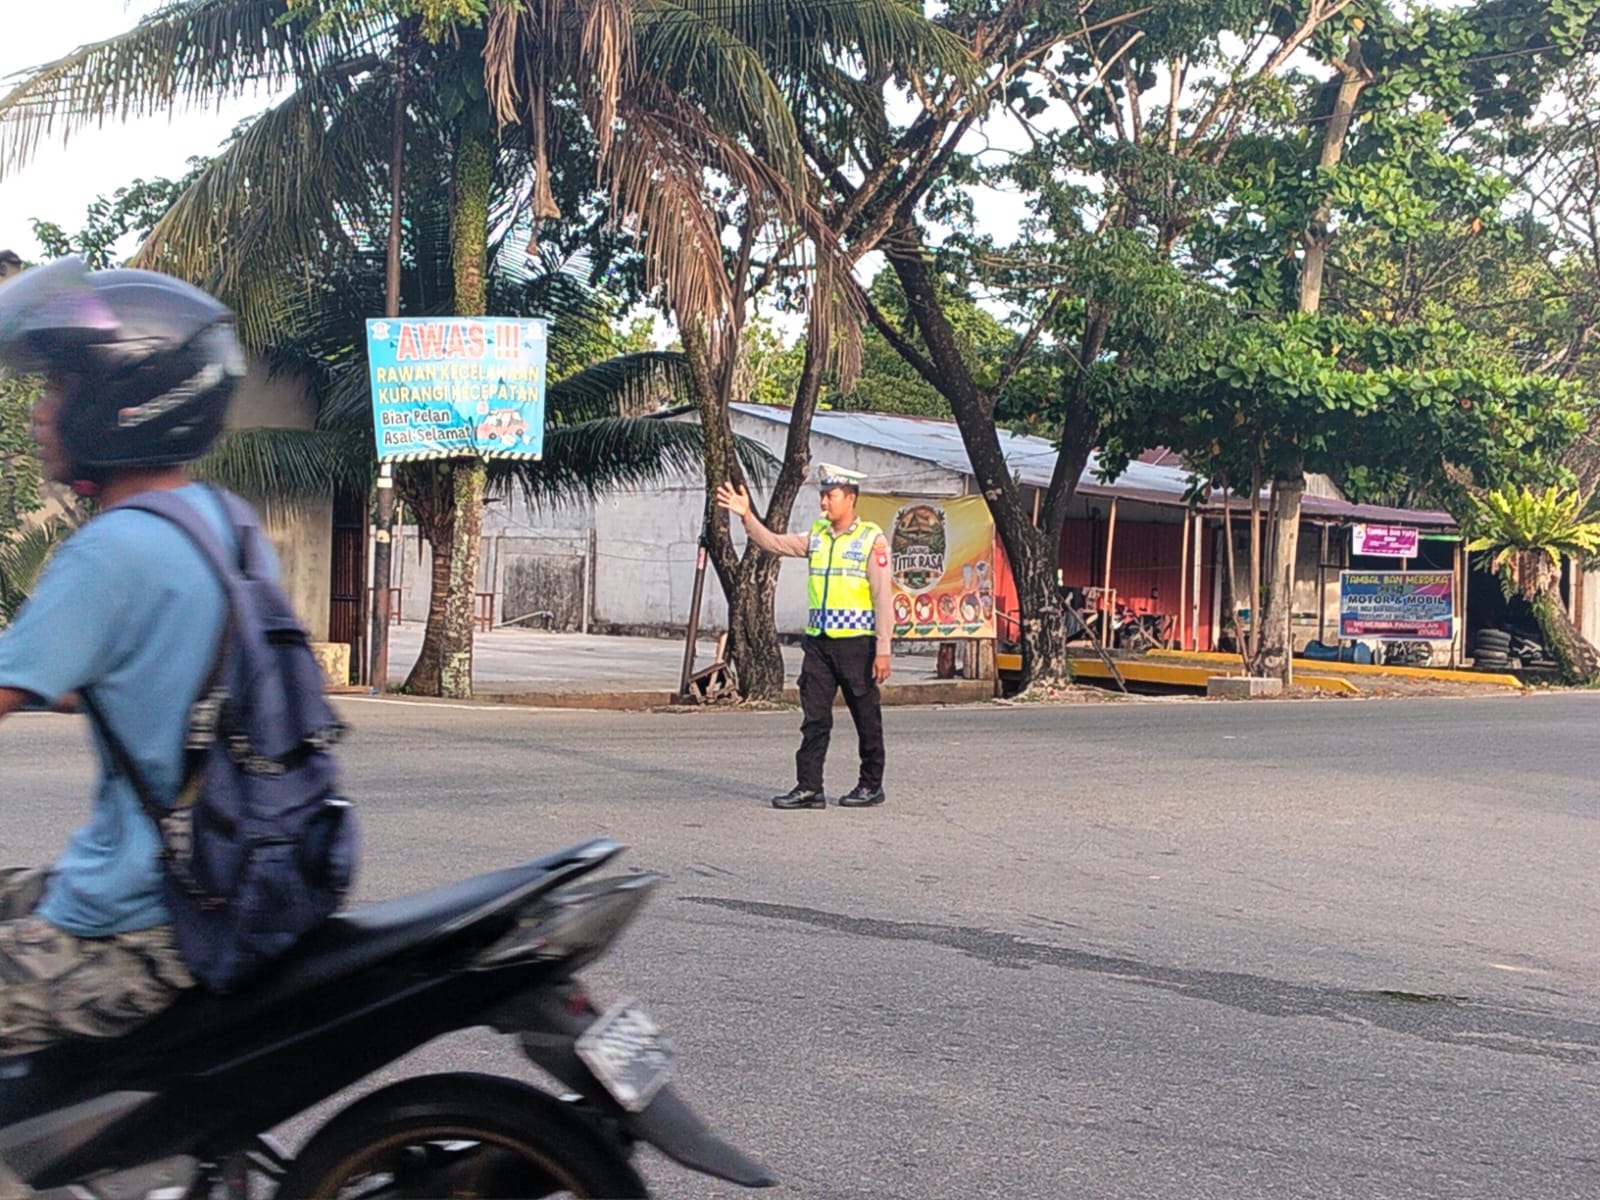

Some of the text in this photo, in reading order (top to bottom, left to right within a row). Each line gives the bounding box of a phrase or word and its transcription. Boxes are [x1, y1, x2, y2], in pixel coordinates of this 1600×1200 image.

[397, 322, 521, 360] AWAS !!!
[376, 365, 539, 383] RAWAN KECELAKAAN
[378, 384, 539, 404] KURANGI KECEPATAN
[382, 409, 450, 425] Biar Pelan
[384, 427, 472, 445] Asal Selamat
[892, 553, 943, 572] TITIK RASA
[1346, 575, 1448, 584] TAMBAL BAN MERDEKA
[1348, 595, 1391, 604] MOTOR
[1407, 595, 1445, 604] MOBIL
